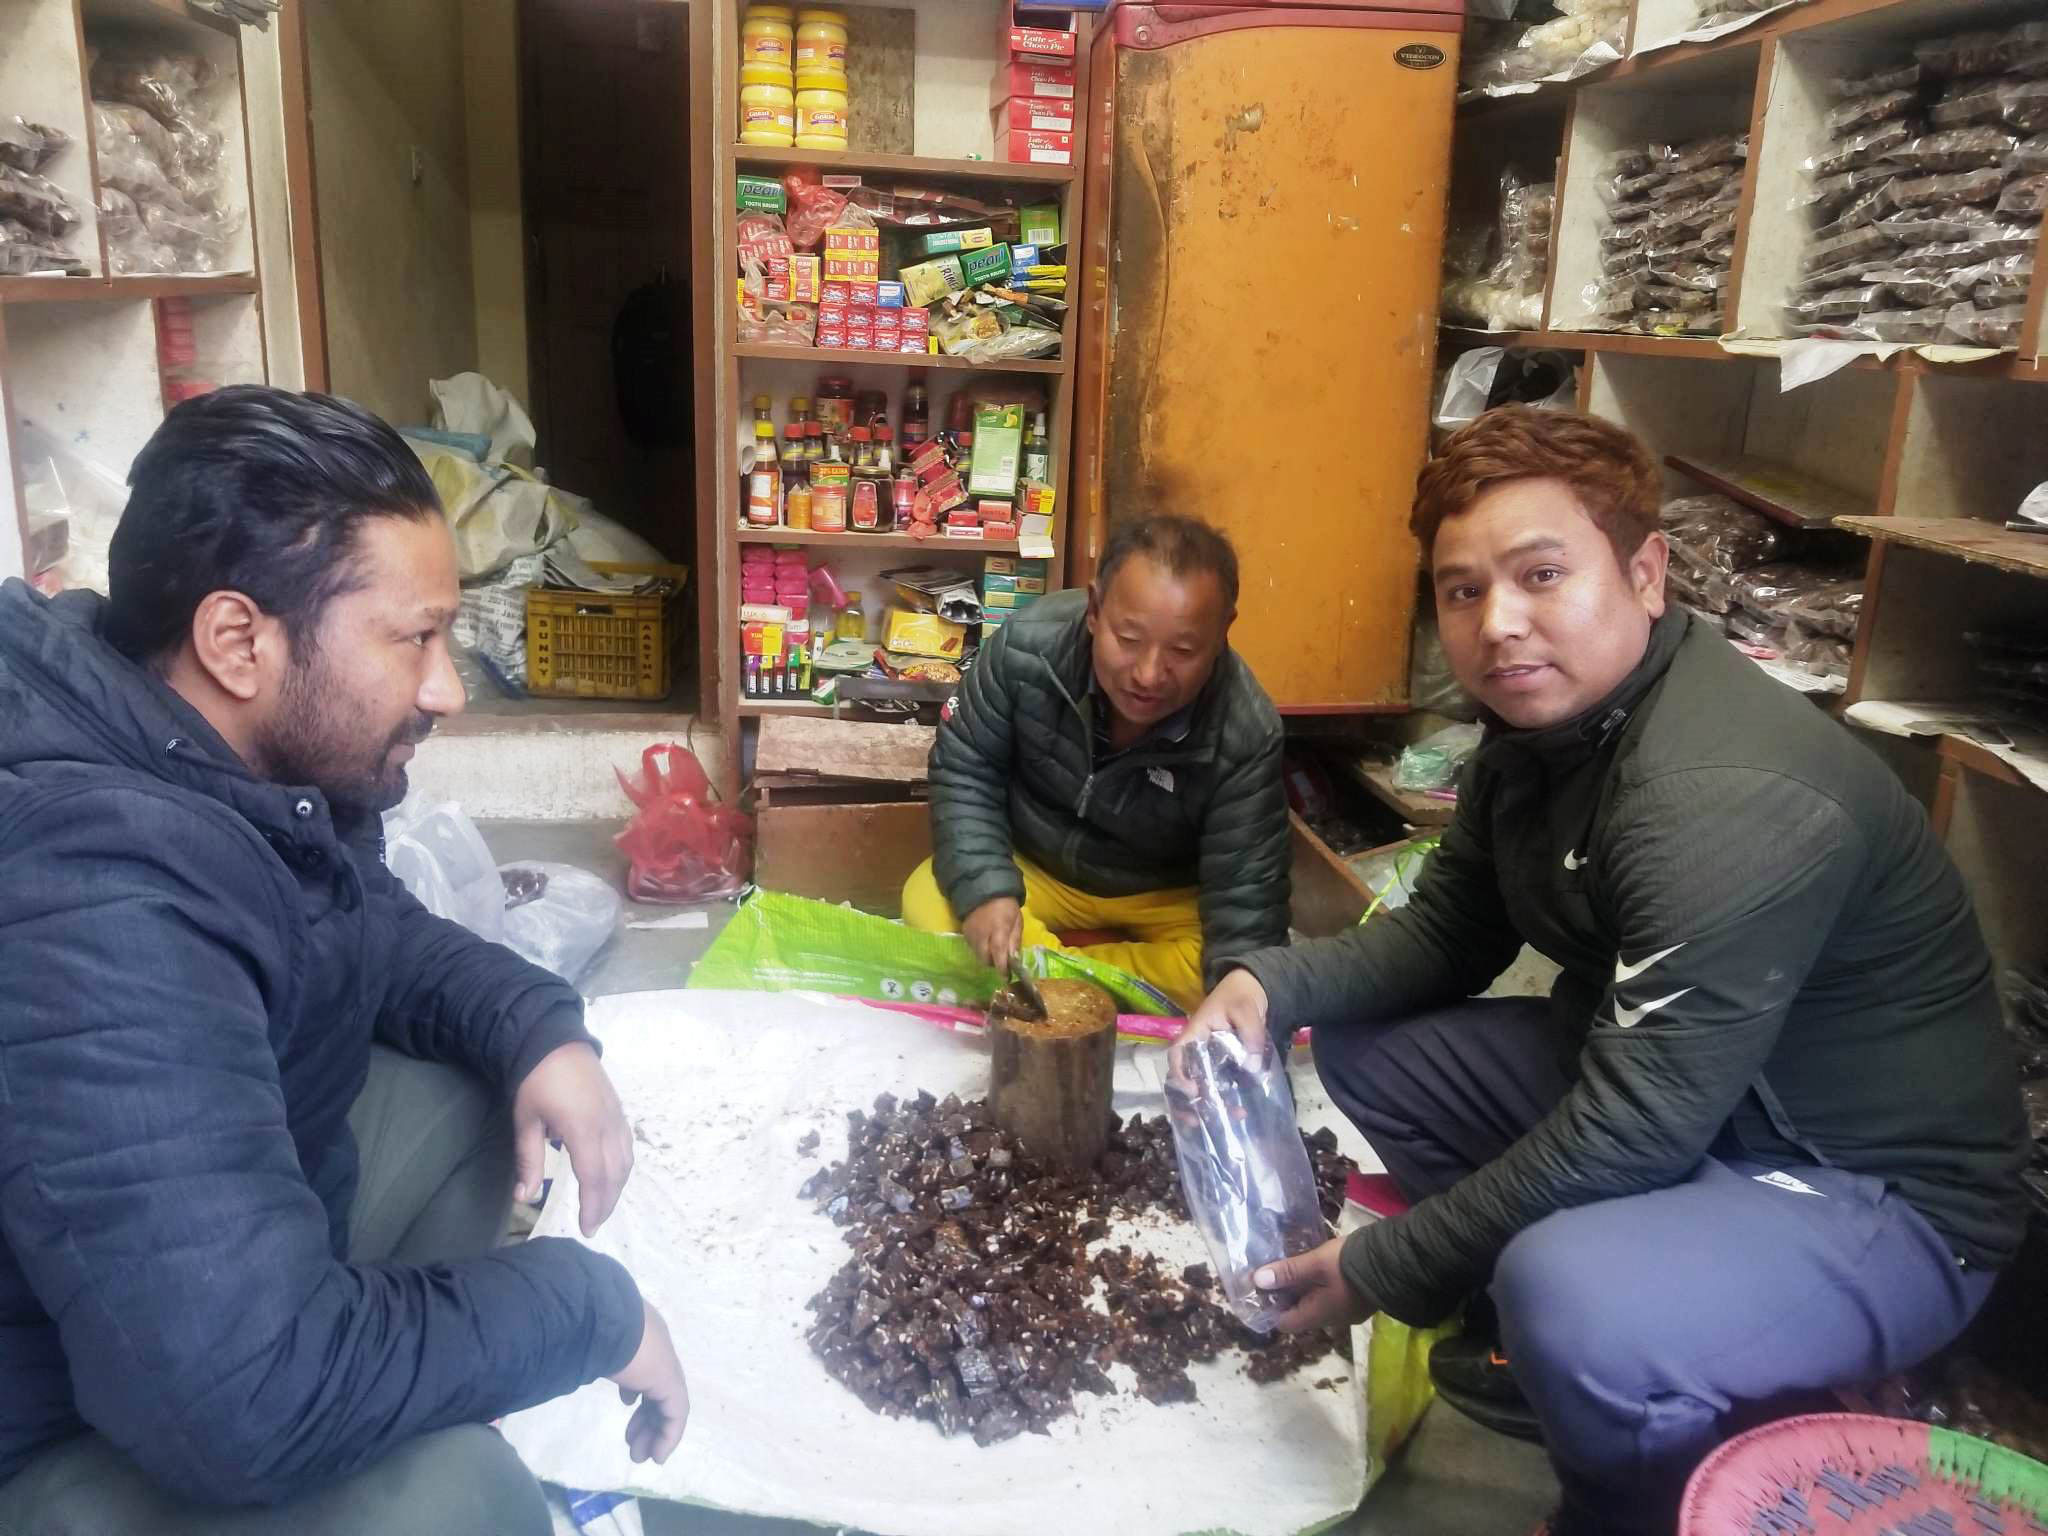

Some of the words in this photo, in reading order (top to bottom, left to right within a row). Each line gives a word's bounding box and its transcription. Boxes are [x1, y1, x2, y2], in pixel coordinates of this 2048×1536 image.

[1023, 34, 1046, 43] Lotte
[1023, 40, 1049, 49] Choco
[1050, 42, 1065, 51] Pie
[974, 273, 990, 282] TOOTH
